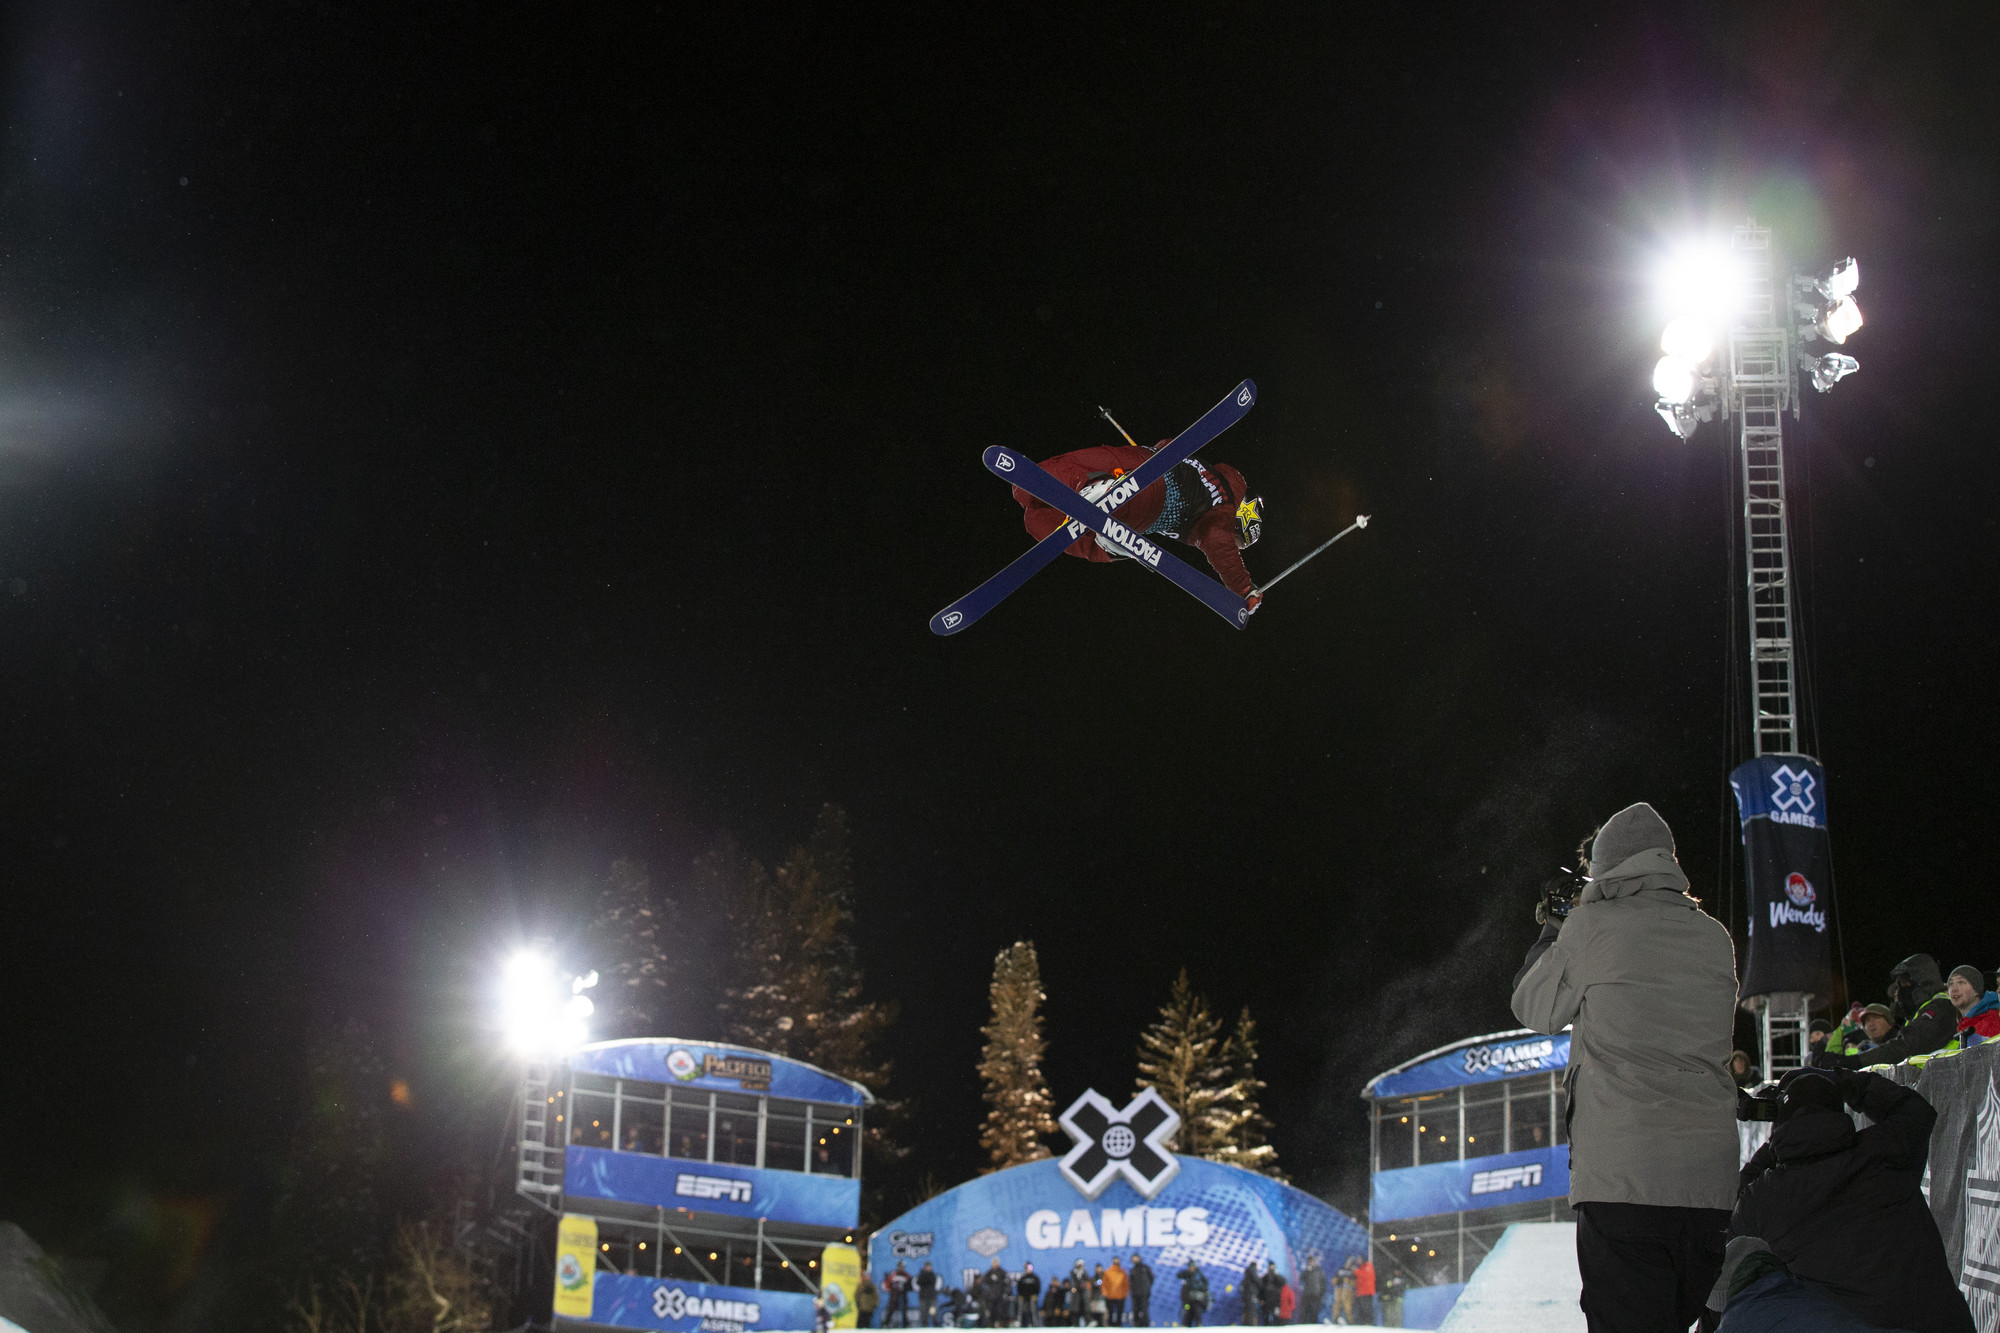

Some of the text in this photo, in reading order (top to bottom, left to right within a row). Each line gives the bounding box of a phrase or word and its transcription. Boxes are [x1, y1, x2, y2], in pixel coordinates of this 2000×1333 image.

[1066, 476, 1140, 540] FATION
[1102, 517, 1163, 567] FACTION
[1770, 809, 1816, 828] GAMES
[1491, 1039, 1553, 1066] GAMES
[675, 1173, 753, 1204] ESPN
[1470, 1163, 1543, 1196] ESPN
[1025, 1206, 1210, 1250] GAMES
[685, 1296, 760, 1324] GAMES
[700, 1318, 744, 1333] ASPEN
